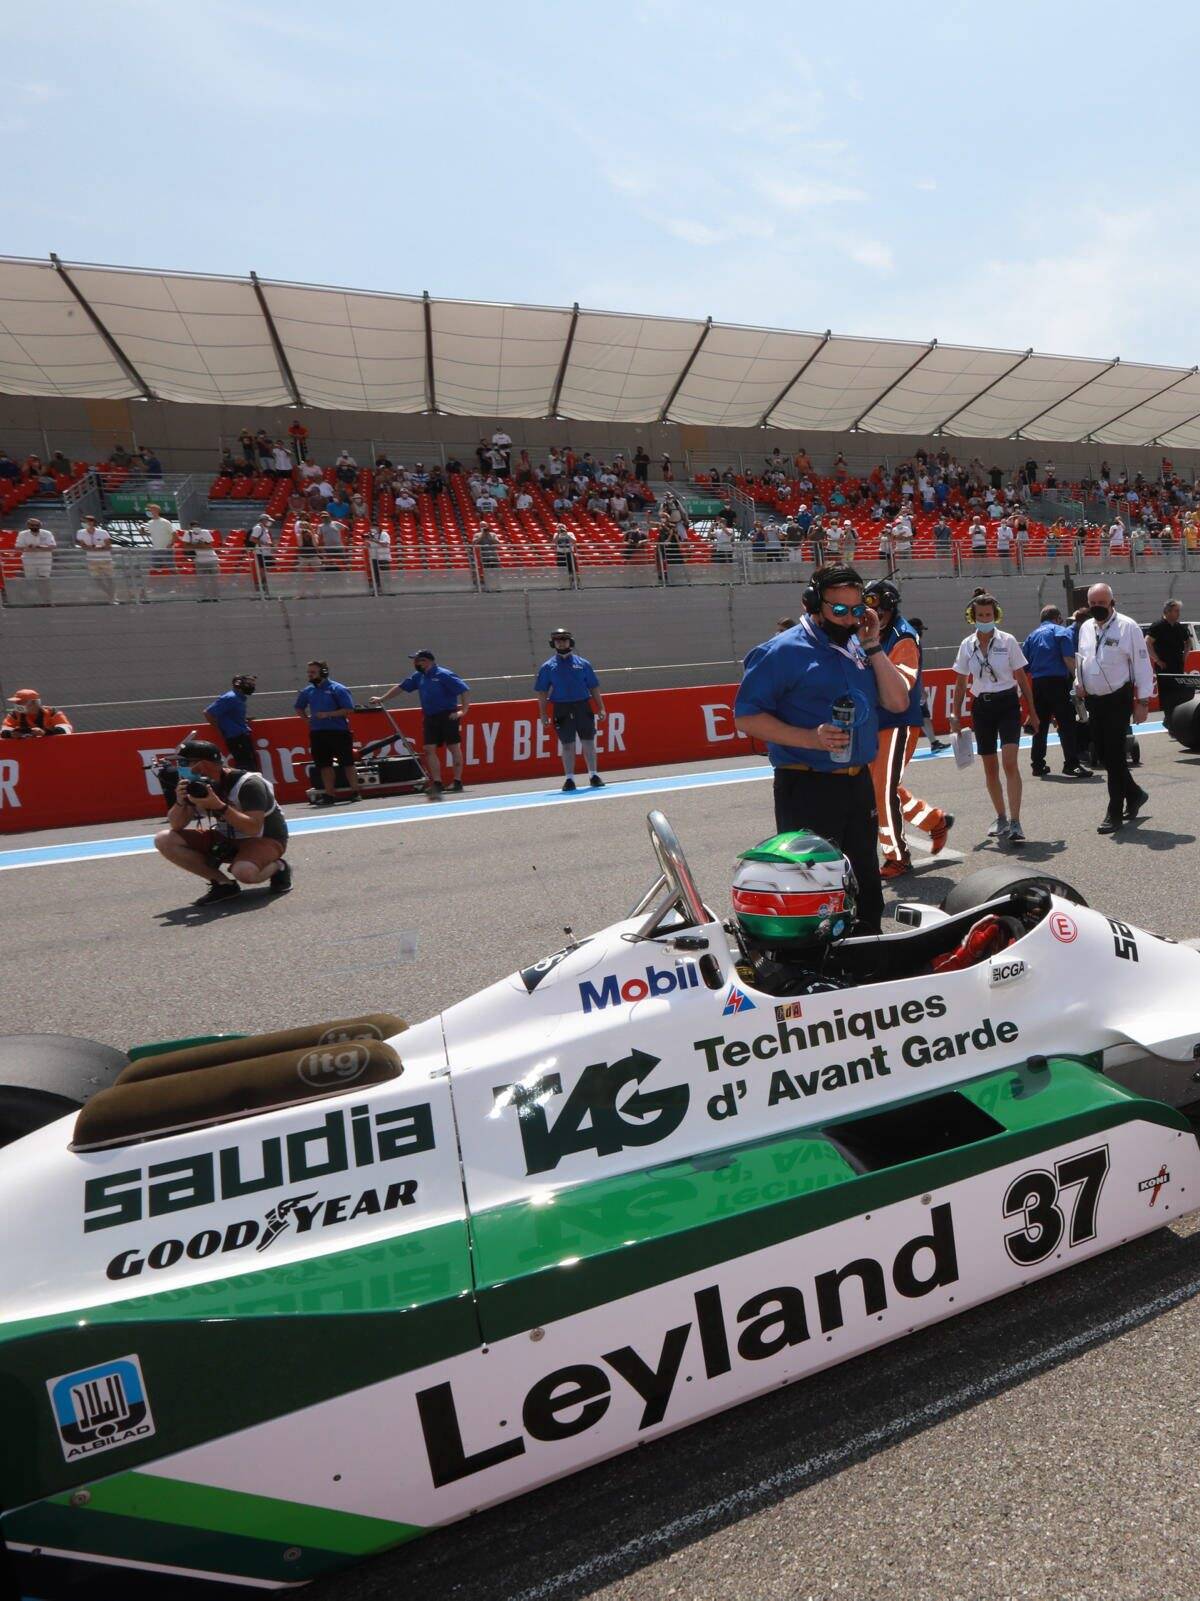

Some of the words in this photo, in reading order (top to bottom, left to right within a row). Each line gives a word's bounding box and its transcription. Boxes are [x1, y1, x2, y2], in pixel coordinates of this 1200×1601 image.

[446, 722, 499, 768] LY
[513, 712, 626, 761] BEER
[578, 957, 700, 1013] Mobil
[1002, 961, 1025, 979] CGA
[309, 1051, 359, 1077] itg
[694, 995, 948, 1073] Techniques
[767, 1045, 892, 1107] Avant
[902, 1020, 1020, 1068] Garde
[493, 1048, 690, 1176] TAG
[84, 1103, 436, 1233] saudia
[1140, 1175, 1168, 1190] KONI
[1003, 1144, 1111, 1267] 37
[415, 1203, 959, 1488] Leyland
[67, 1425, 151, 1458] ALBILAD
